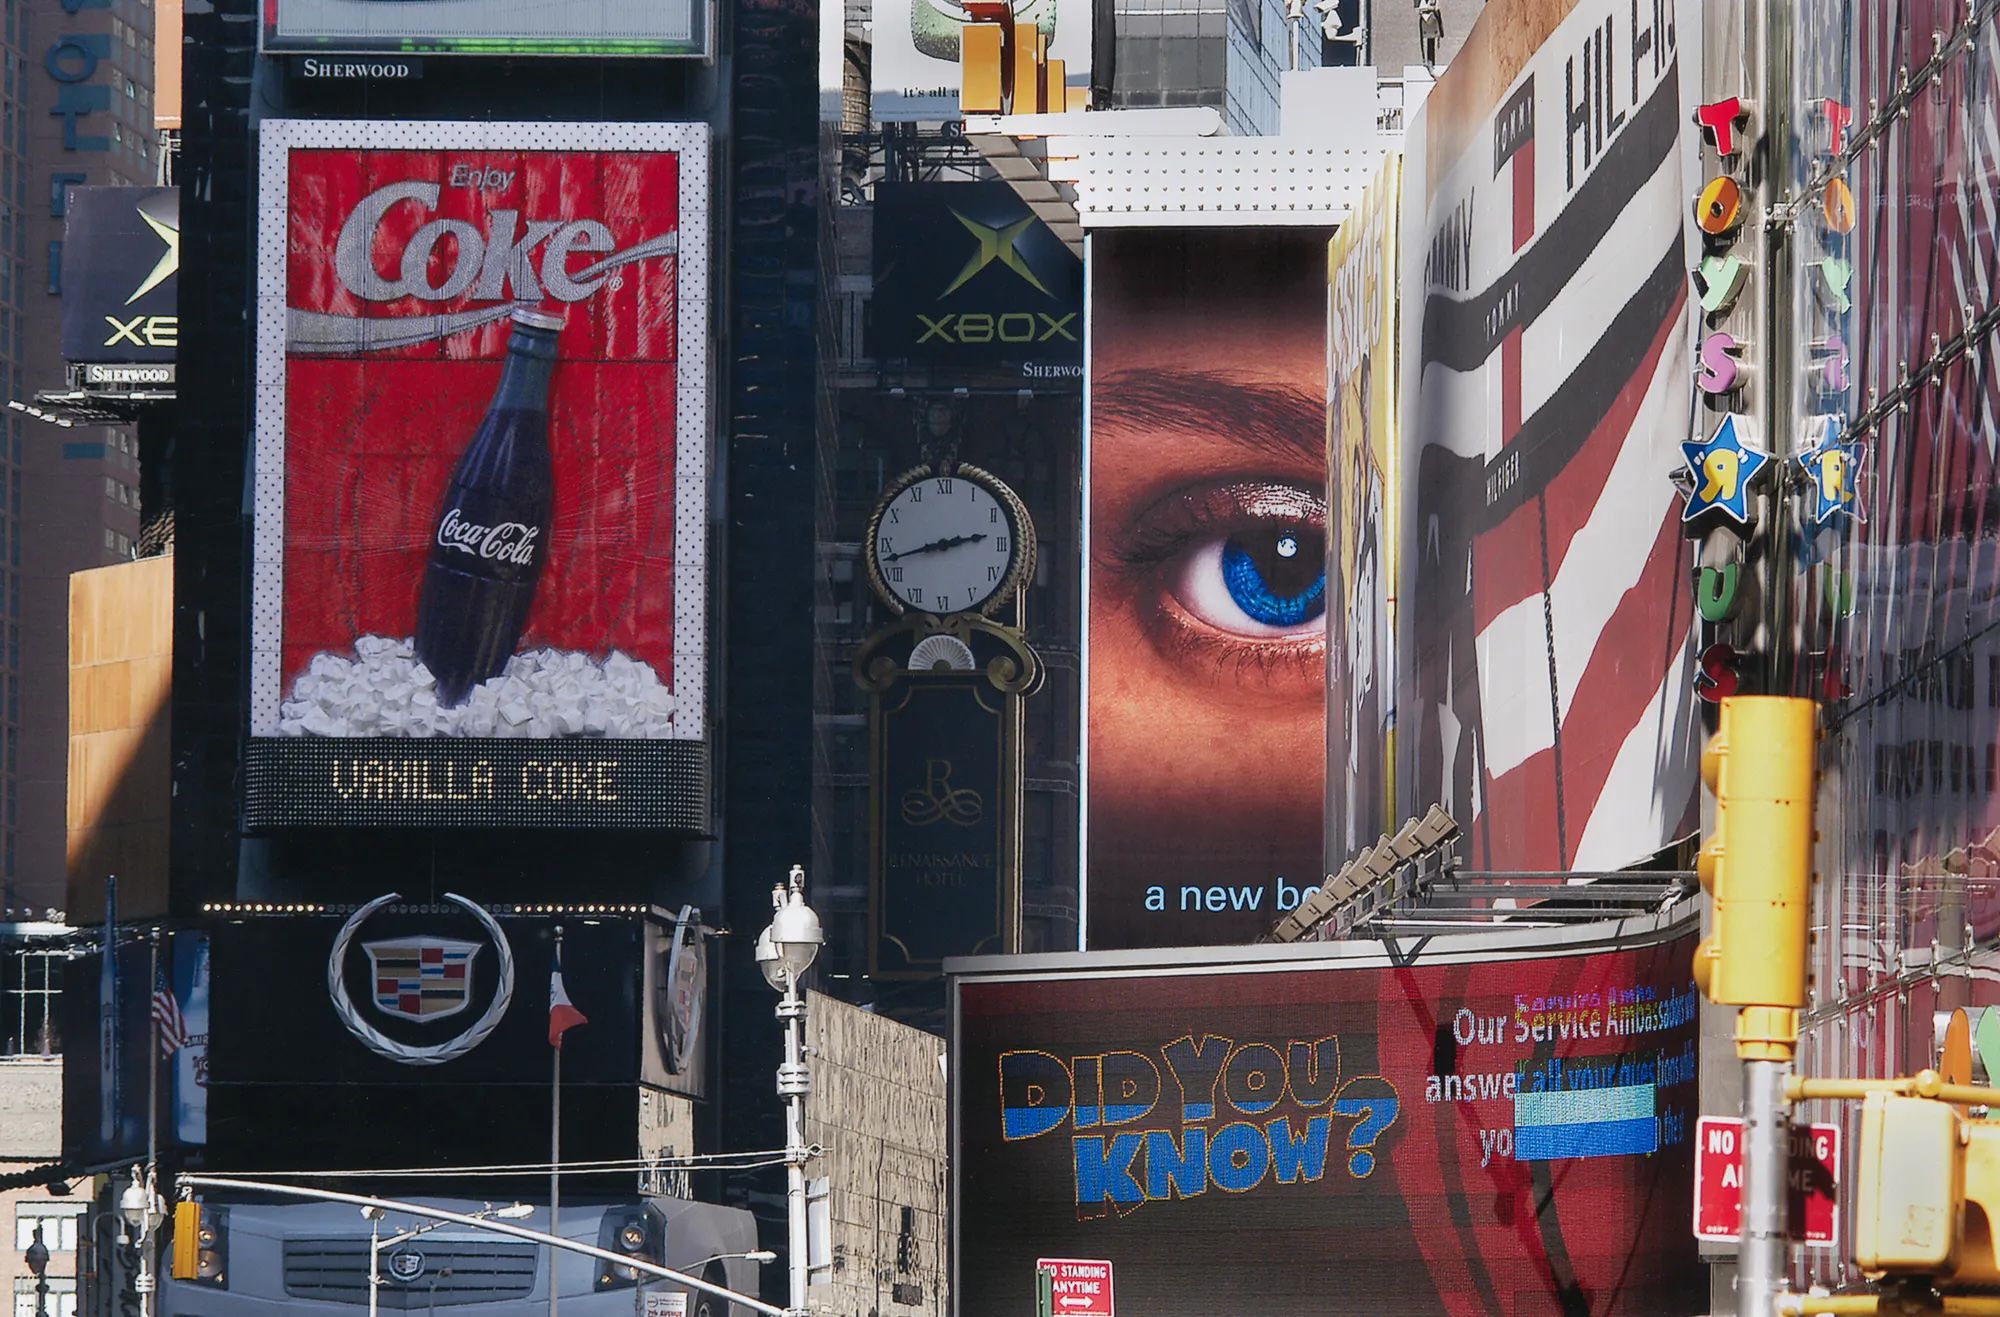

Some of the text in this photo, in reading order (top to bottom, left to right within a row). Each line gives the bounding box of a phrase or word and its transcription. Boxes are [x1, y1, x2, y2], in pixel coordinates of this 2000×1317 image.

[303, 58, 410, 79] SHERWOOD
[1494, 95, 1533, 166] TOMMY
[450, 163, 516, 191] Enjoy
[335, 180, 617, 302] Coke
[1697, 96, 1741, 394] TOYS
[1485, 281, 1520, 343] TOMMY
[916, 312, 1078, 344] XBOX
[91, 364, 170, 383] SHERWOOD
[1022, 361, 1086, 378] SHERWO
[910, 487, 922, 503] XI
[937, 479, 952, 495] XII
[971, 487, 975, 502] I
[890, 508, 899, 524] X
[990, 508, 997, 523] II
[437, 508, 540, 566] Coca-Cola
[881, 537, 893, 553] IX
[996, 537, 1007, 552] III
[884, 567, 903, 582] VIII
[987, 566, 1000, 582] IV
[907, 588, 922, 603] VII
[937, 596, 949, 611] VI
[968, 587, 977, 602] V
[332, 759, 618, 800] VANILLA COKE
[1145, 886, 1165, 911] a
[1180, 886, 1264, 911] new
[1453, 1007, 1508, 1046] Our
[999, 1034, 1342, 1142] DID YOU
[1425, 1067, 1526, 1104] answer
[1071, 1075, 1402, 1222] KNOW?
[1479, 1127, 1515, 1169] yo
[1708, 1129, 1735, 1156] NO
[1061, 1265, 1107, 1279] STANDING
[1052, 1280, 1101, 1295] ANYTIME
